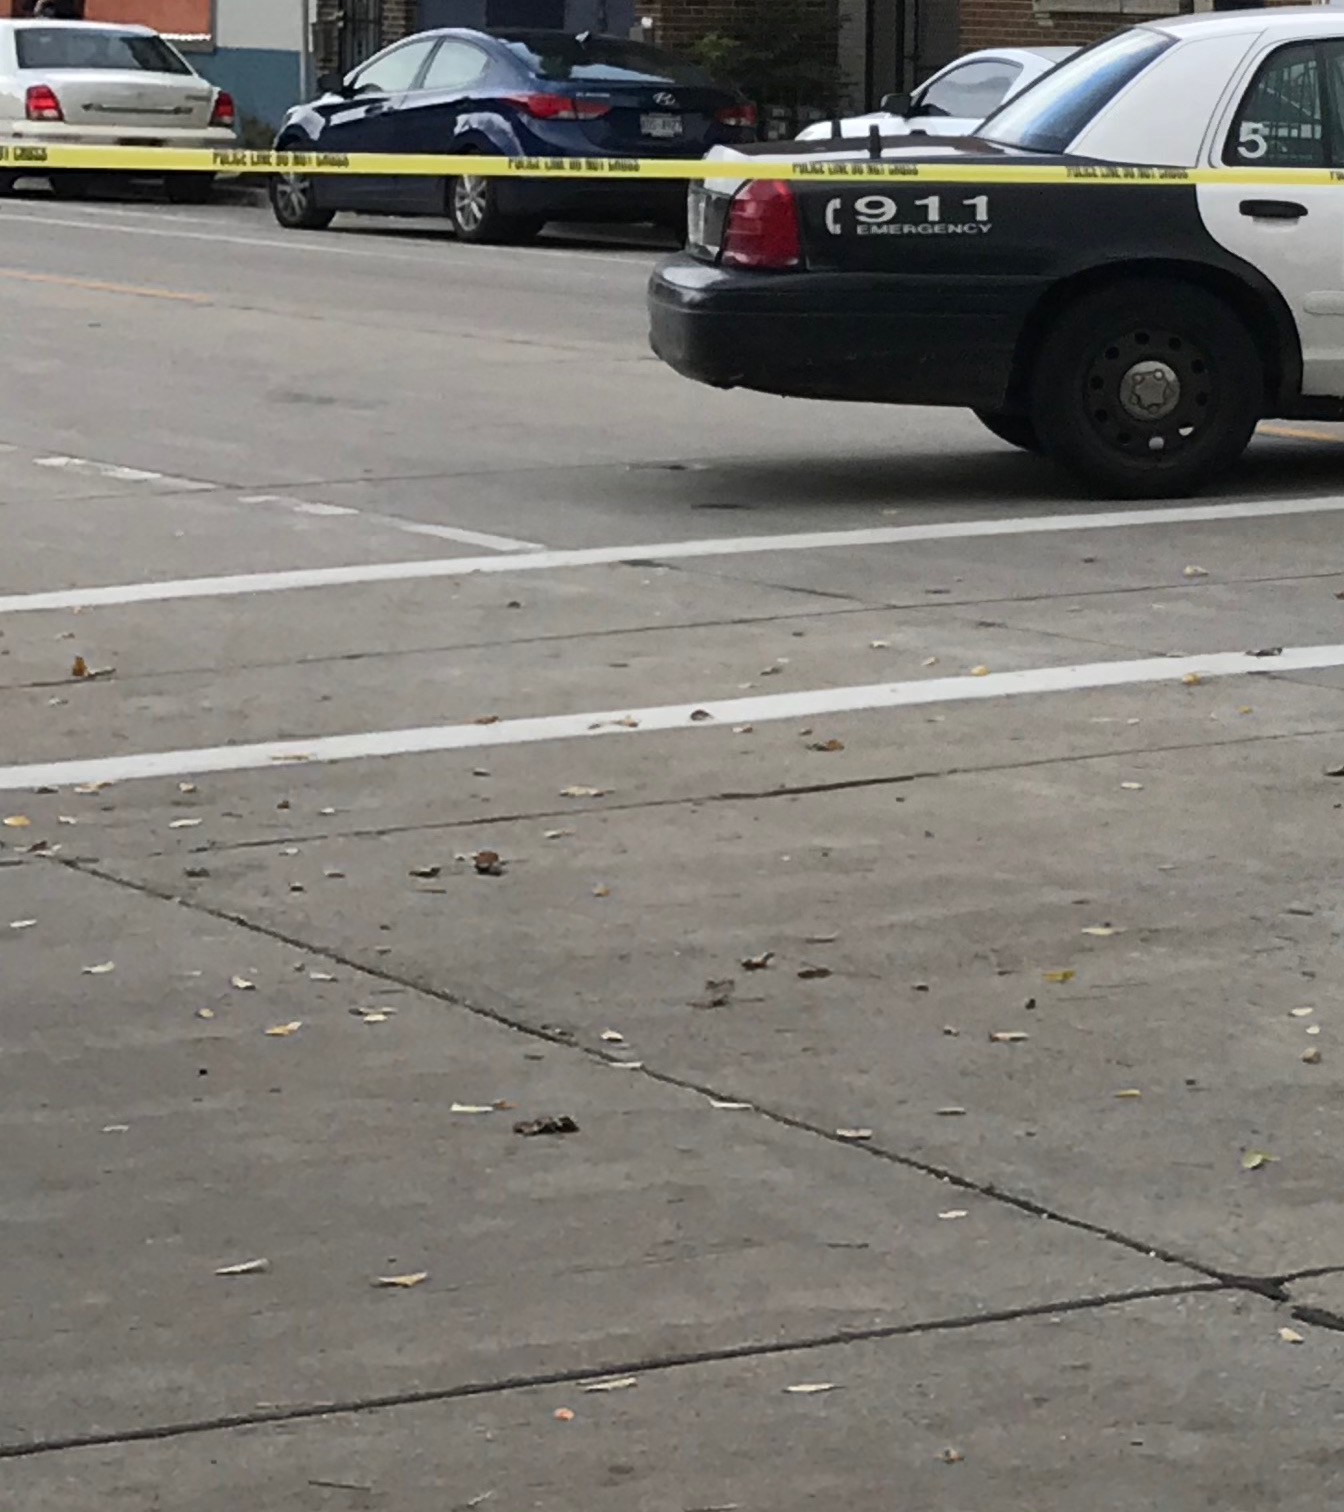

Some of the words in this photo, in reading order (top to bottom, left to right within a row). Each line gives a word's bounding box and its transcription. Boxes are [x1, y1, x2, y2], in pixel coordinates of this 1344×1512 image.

[1237, 121, 1267, 158] 5
[854, 195, 989, 223] 911
[857, 223, 992, 235] EMERGENCY
